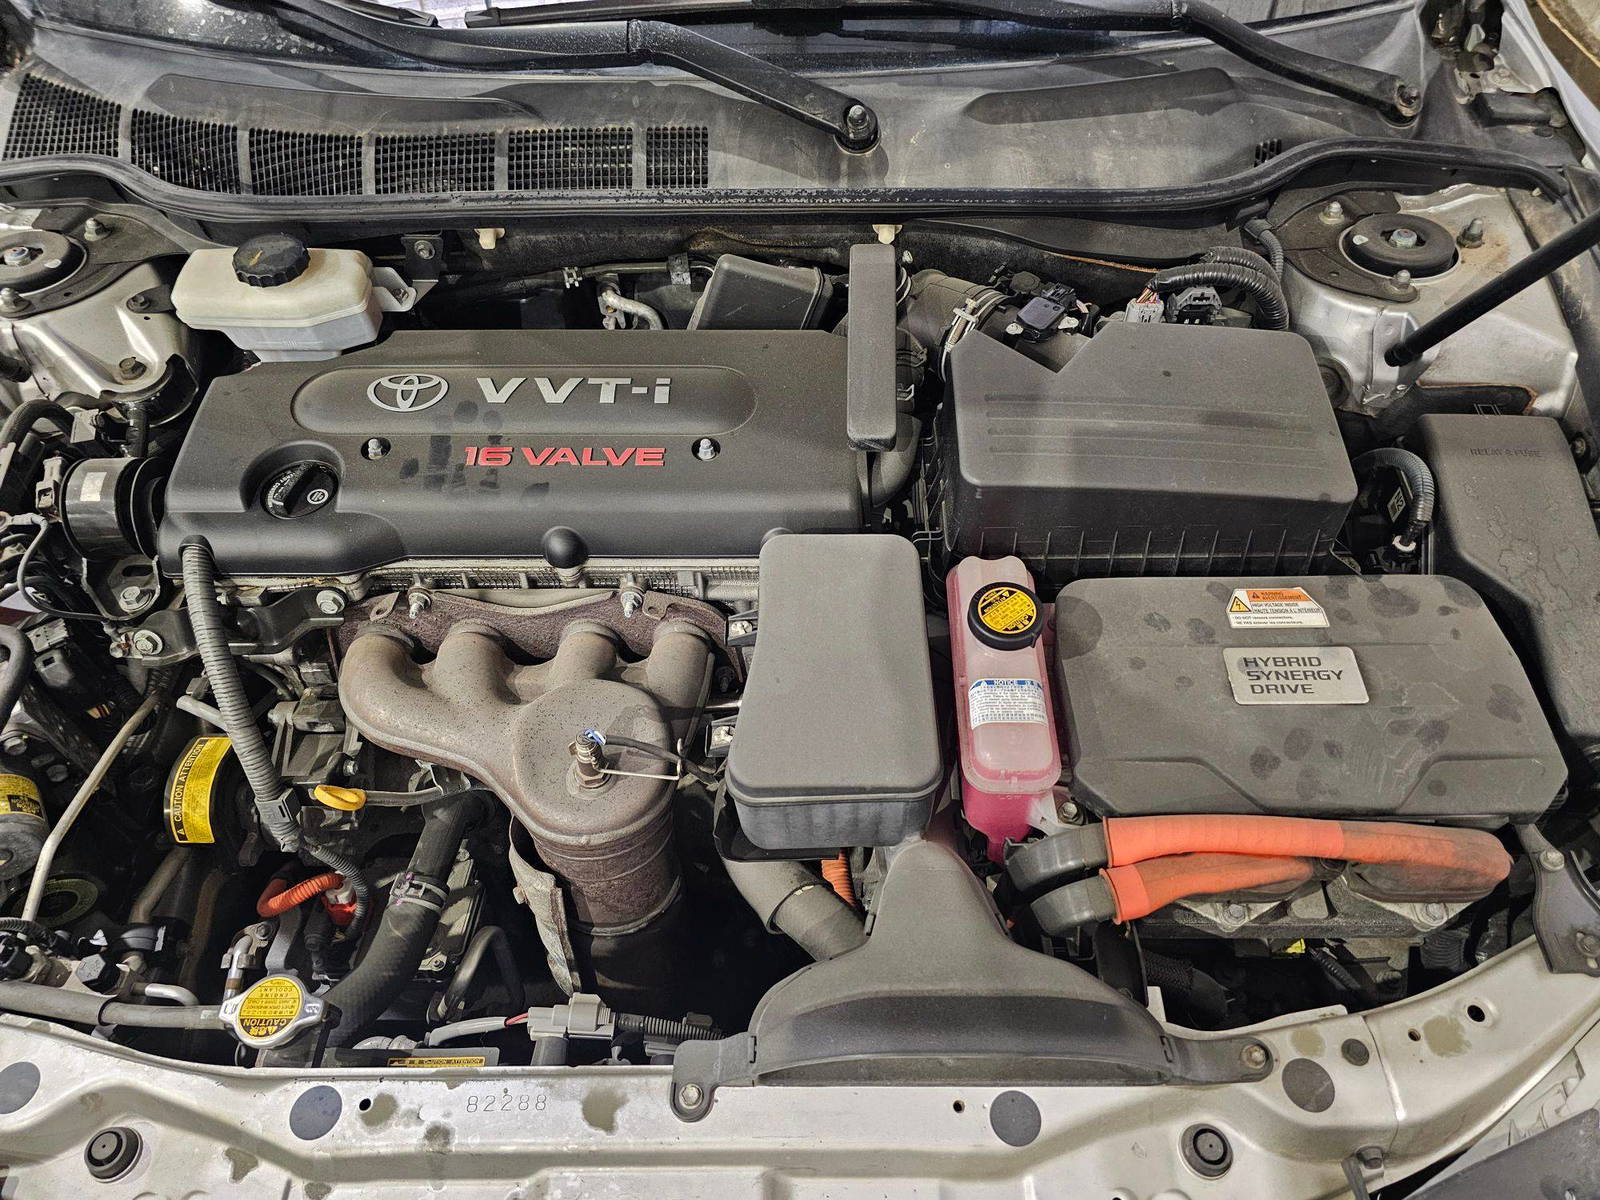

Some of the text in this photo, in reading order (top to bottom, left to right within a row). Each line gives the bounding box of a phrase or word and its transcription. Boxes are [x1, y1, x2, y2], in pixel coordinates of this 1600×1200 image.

[477, 378, 671, 404] VVT-i
[464, 446, 666, 466] 16 VALVE
[1243, 656, 1322, 667] HYBRID
[1246, 670, 1343, 681] SYNERGY
[1250, 684, 1315, 694] DRIVE
[179, 744, 204, 782] ATTENTION
[174, 785, 185, 822] CAUTION
[243, 1018, 287, 1027] CAUTION
[466, 1094, 547, 1113] 82288
